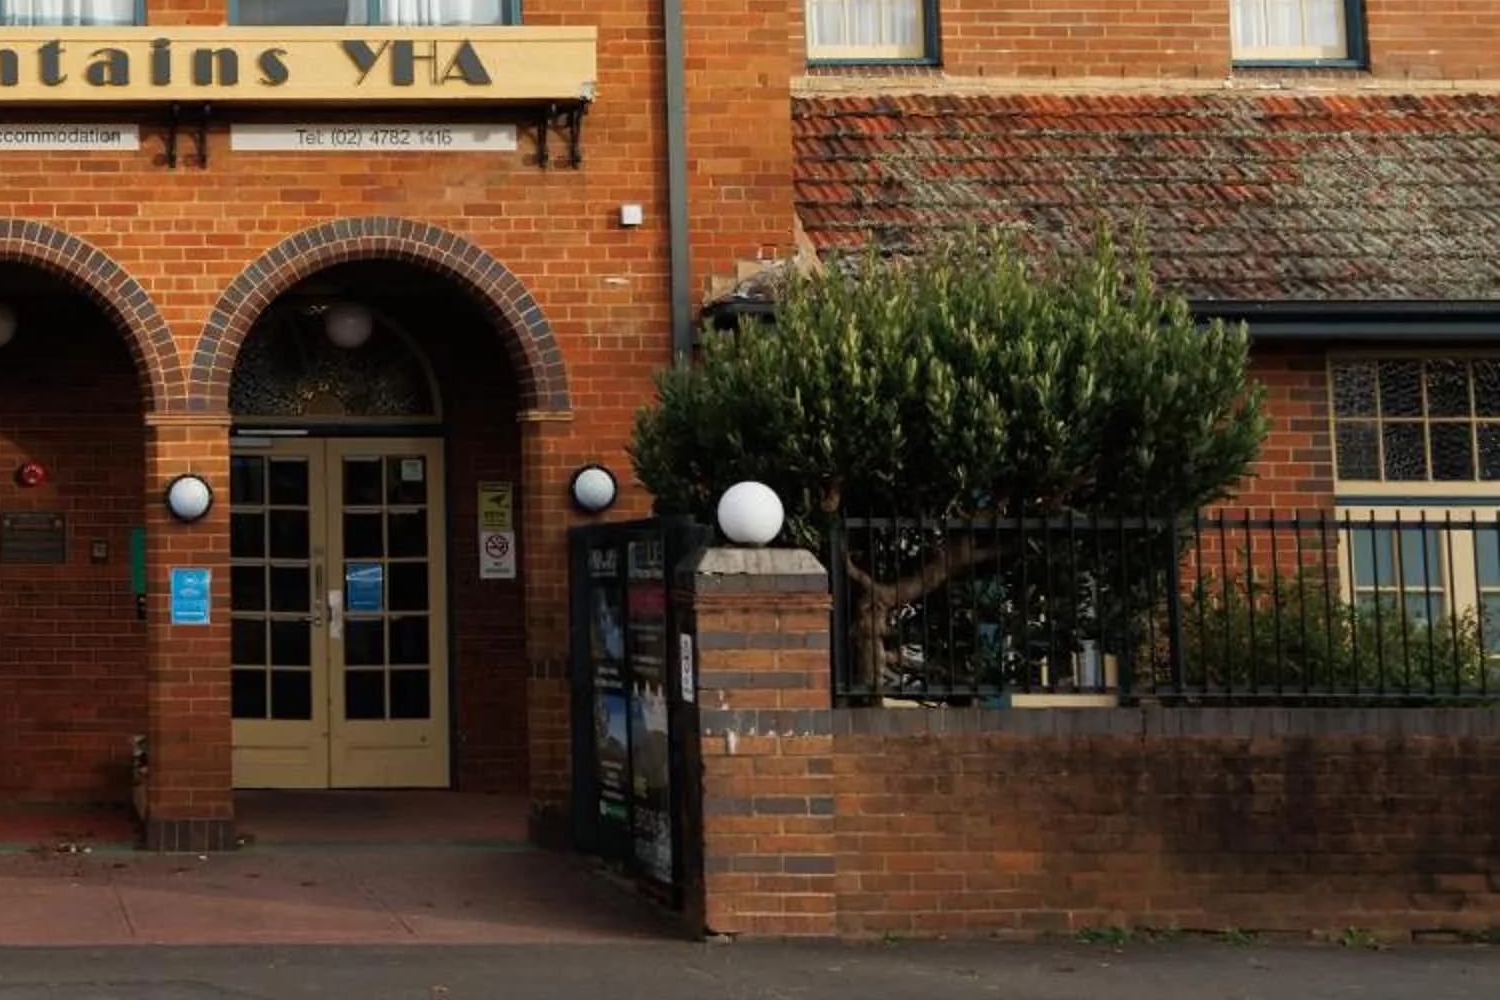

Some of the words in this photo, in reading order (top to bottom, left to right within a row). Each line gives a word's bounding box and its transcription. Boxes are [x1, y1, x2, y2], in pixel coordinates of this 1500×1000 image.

[341, 40, 492, 87] YHA
[330, 129, 362, 146] (02)
[369, 129, 410, 145] 4782
[418, 129, 453, 145] 1416
